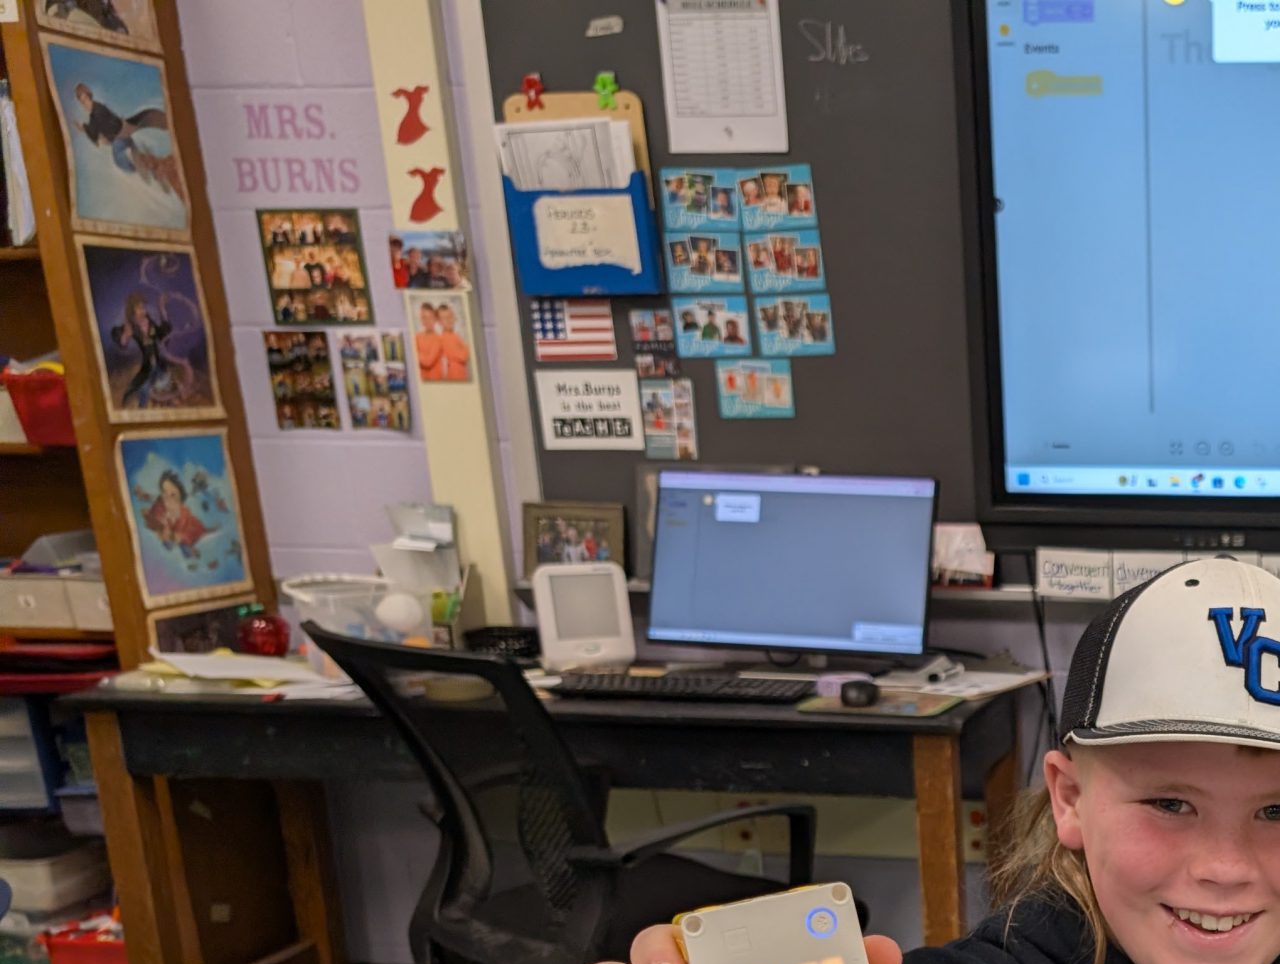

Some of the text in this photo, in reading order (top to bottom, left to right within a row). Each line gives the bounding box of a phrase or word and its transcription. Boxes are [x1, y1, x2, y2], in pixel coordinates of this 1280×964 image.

[1237, 1, 1266, 12] Press
[1024, 43, 1059, 56] Events
[1161, 29, 1212, 64] Th
[242, 103, 336, 140] MRS.
[232, 157, 360, 193] BURNS
[576, 401, 594, 411] the
[600, 401, 621, 411] best
